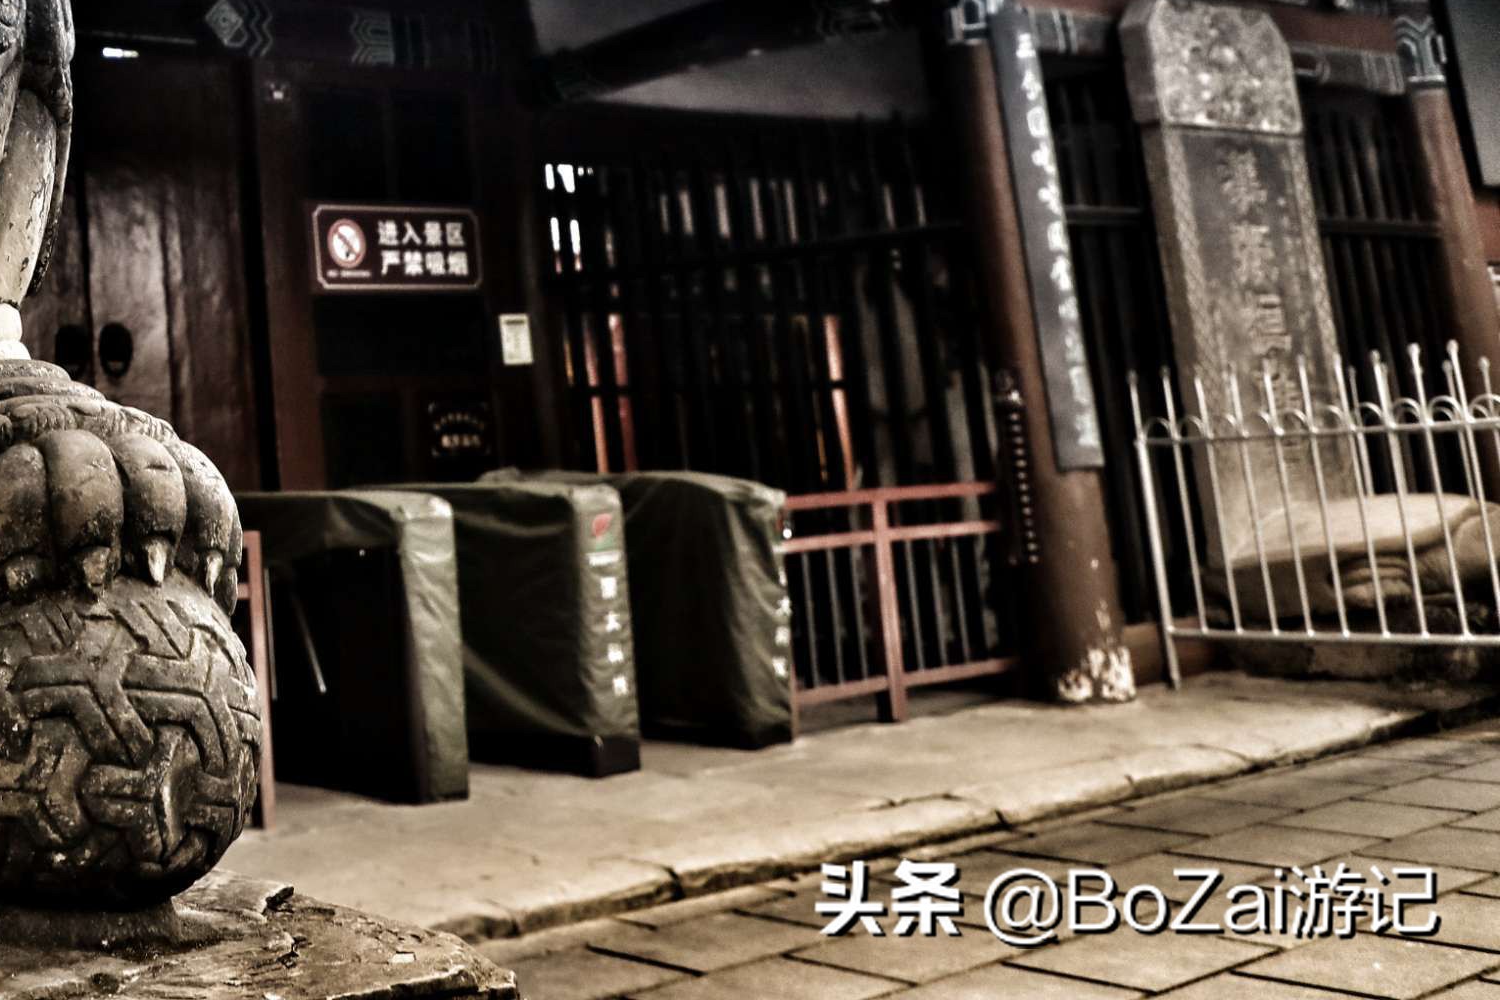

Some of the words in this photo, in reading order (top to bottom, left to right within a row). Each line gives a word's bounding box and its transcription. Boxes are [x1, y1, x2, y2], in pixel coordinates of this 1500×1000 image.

[377, 219, 467, 248] 进入景区
[380, 250, 470, 277] 严禁吸烟
